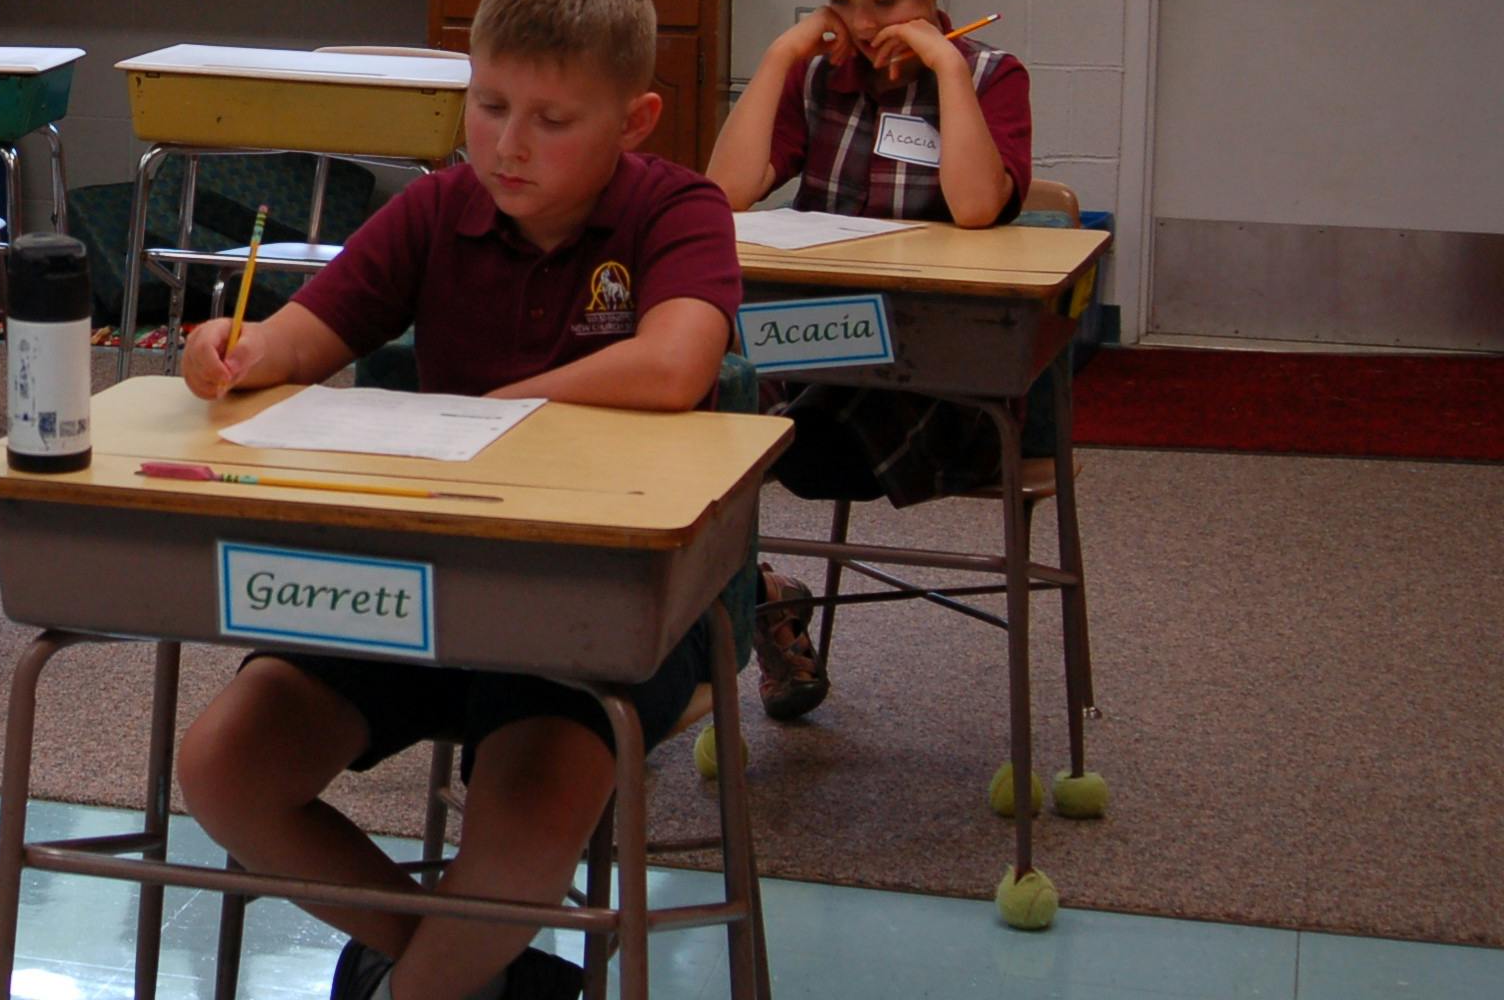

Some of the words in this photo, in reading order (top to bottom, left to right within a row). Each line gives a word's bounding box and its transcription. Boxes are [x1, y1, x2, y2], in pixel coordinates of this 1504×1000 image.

[885, 129, 936, 149] Acacia
[754, 315, 874, 346] Acacia
[246, 571, 411, 618] Garrett
